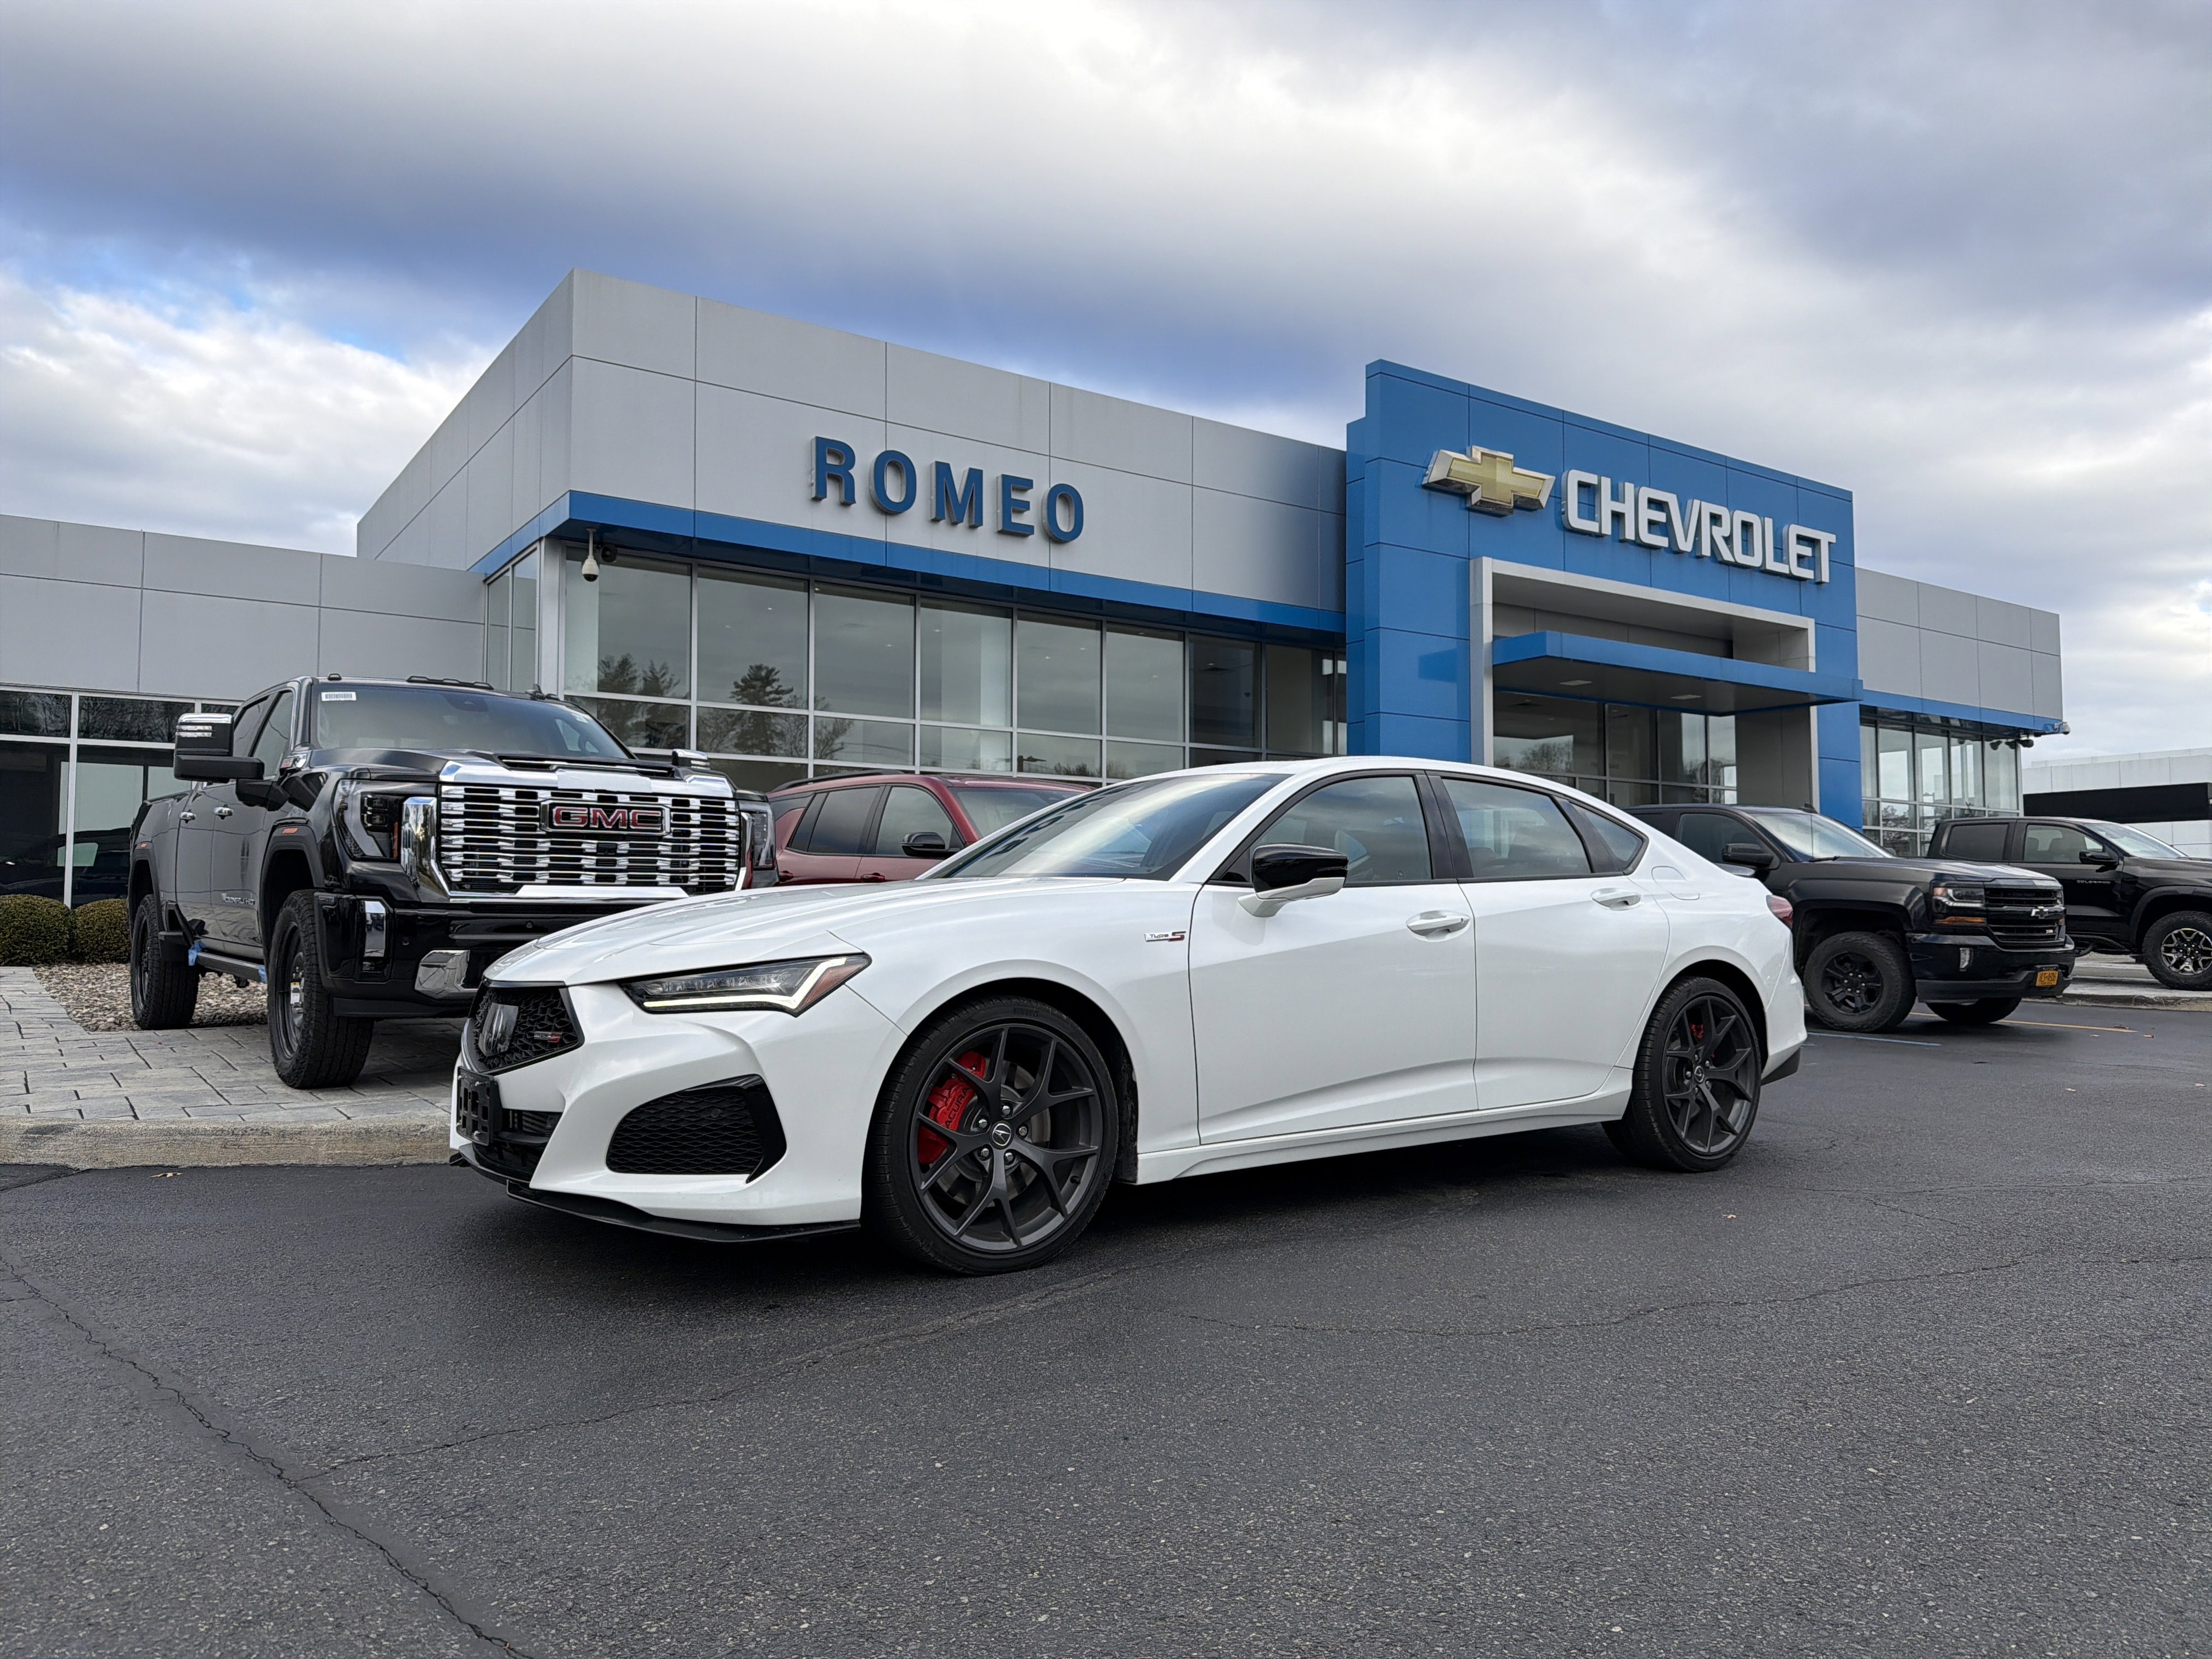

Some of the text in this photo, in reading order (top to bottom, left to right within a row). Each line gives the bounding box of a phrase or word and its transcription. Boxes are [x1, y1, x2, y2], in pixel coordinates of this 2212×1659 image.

[811, 436, 1084, 543] ROMEO
[1562, 469, 1836, 584] CHEVROLET
[553, 807, 662, 829] GMC
[1168, 930, 1187, 942] S
[945, 1088, 970, 1129] ACURA
